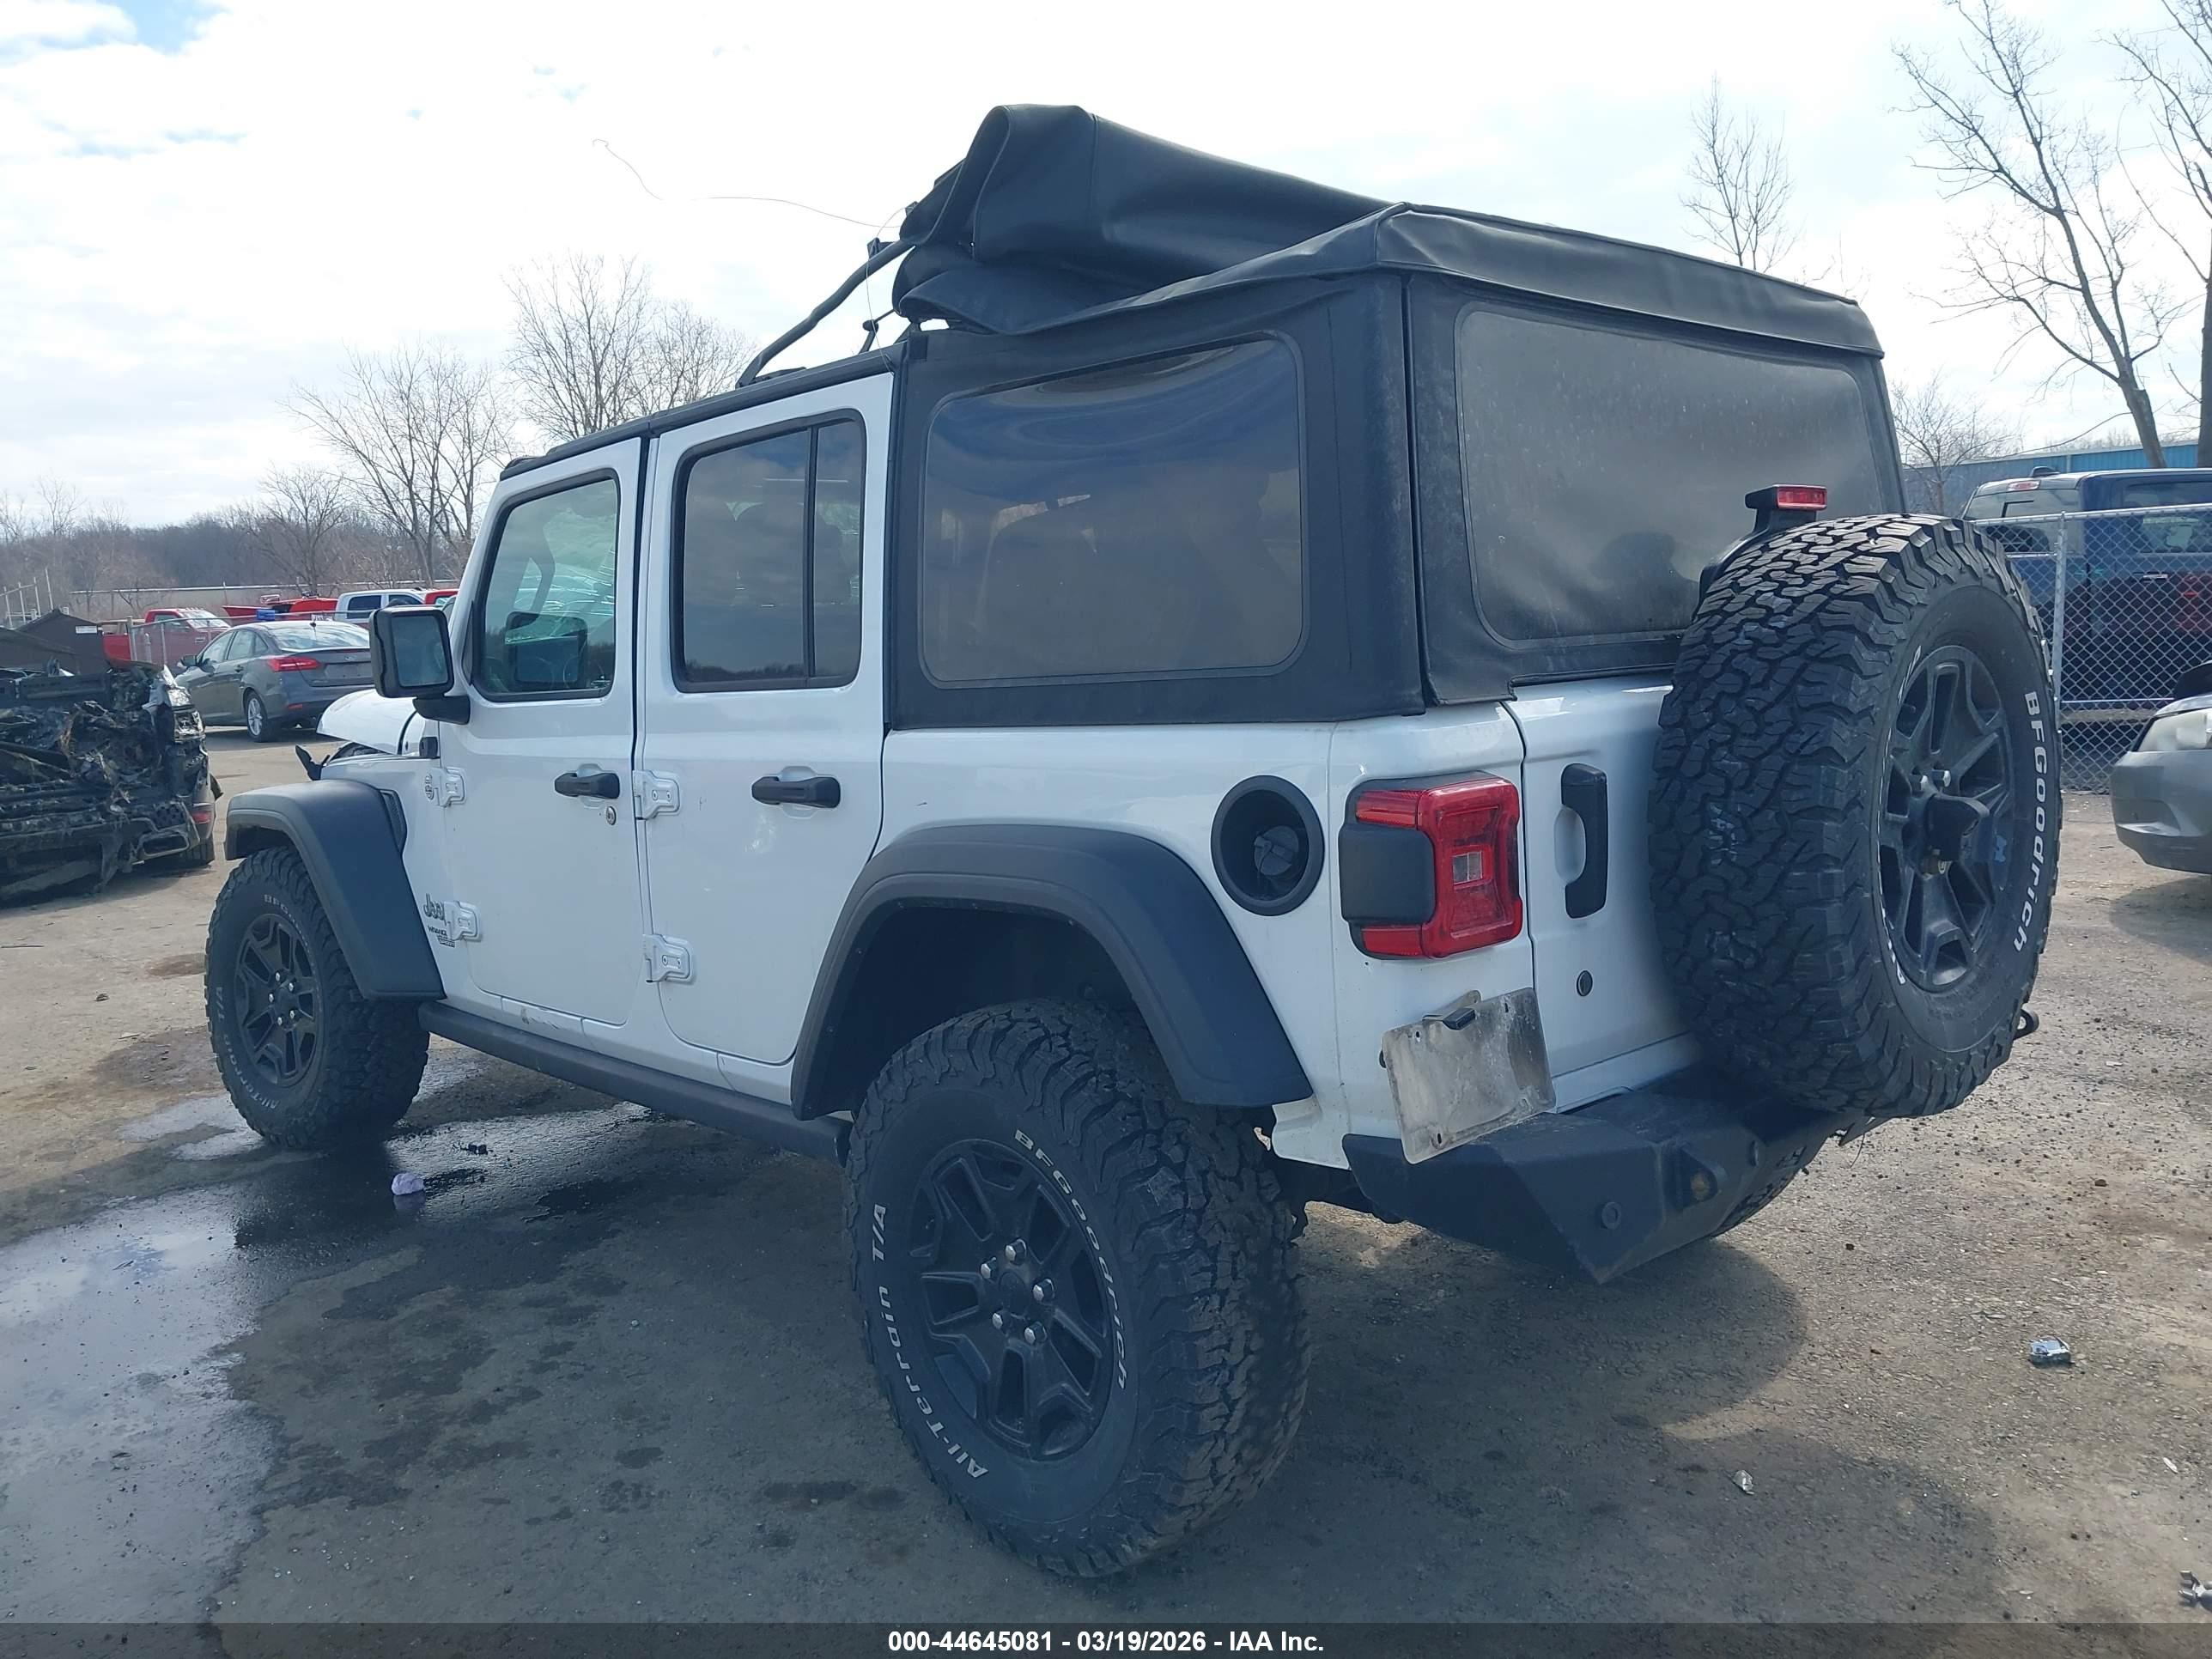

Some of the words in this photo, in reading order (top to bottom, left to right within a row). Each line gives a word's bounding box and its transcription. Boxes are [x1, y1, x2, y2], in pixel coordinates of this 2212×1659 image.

[2014, 690, 2048, 952] BFGoodrich
[872, 1203, 887, 1261] T/A
[1014, 1129, 1127, 1389] BFGoodrich
[878, 1285, 988, 1479] All-Terrain
